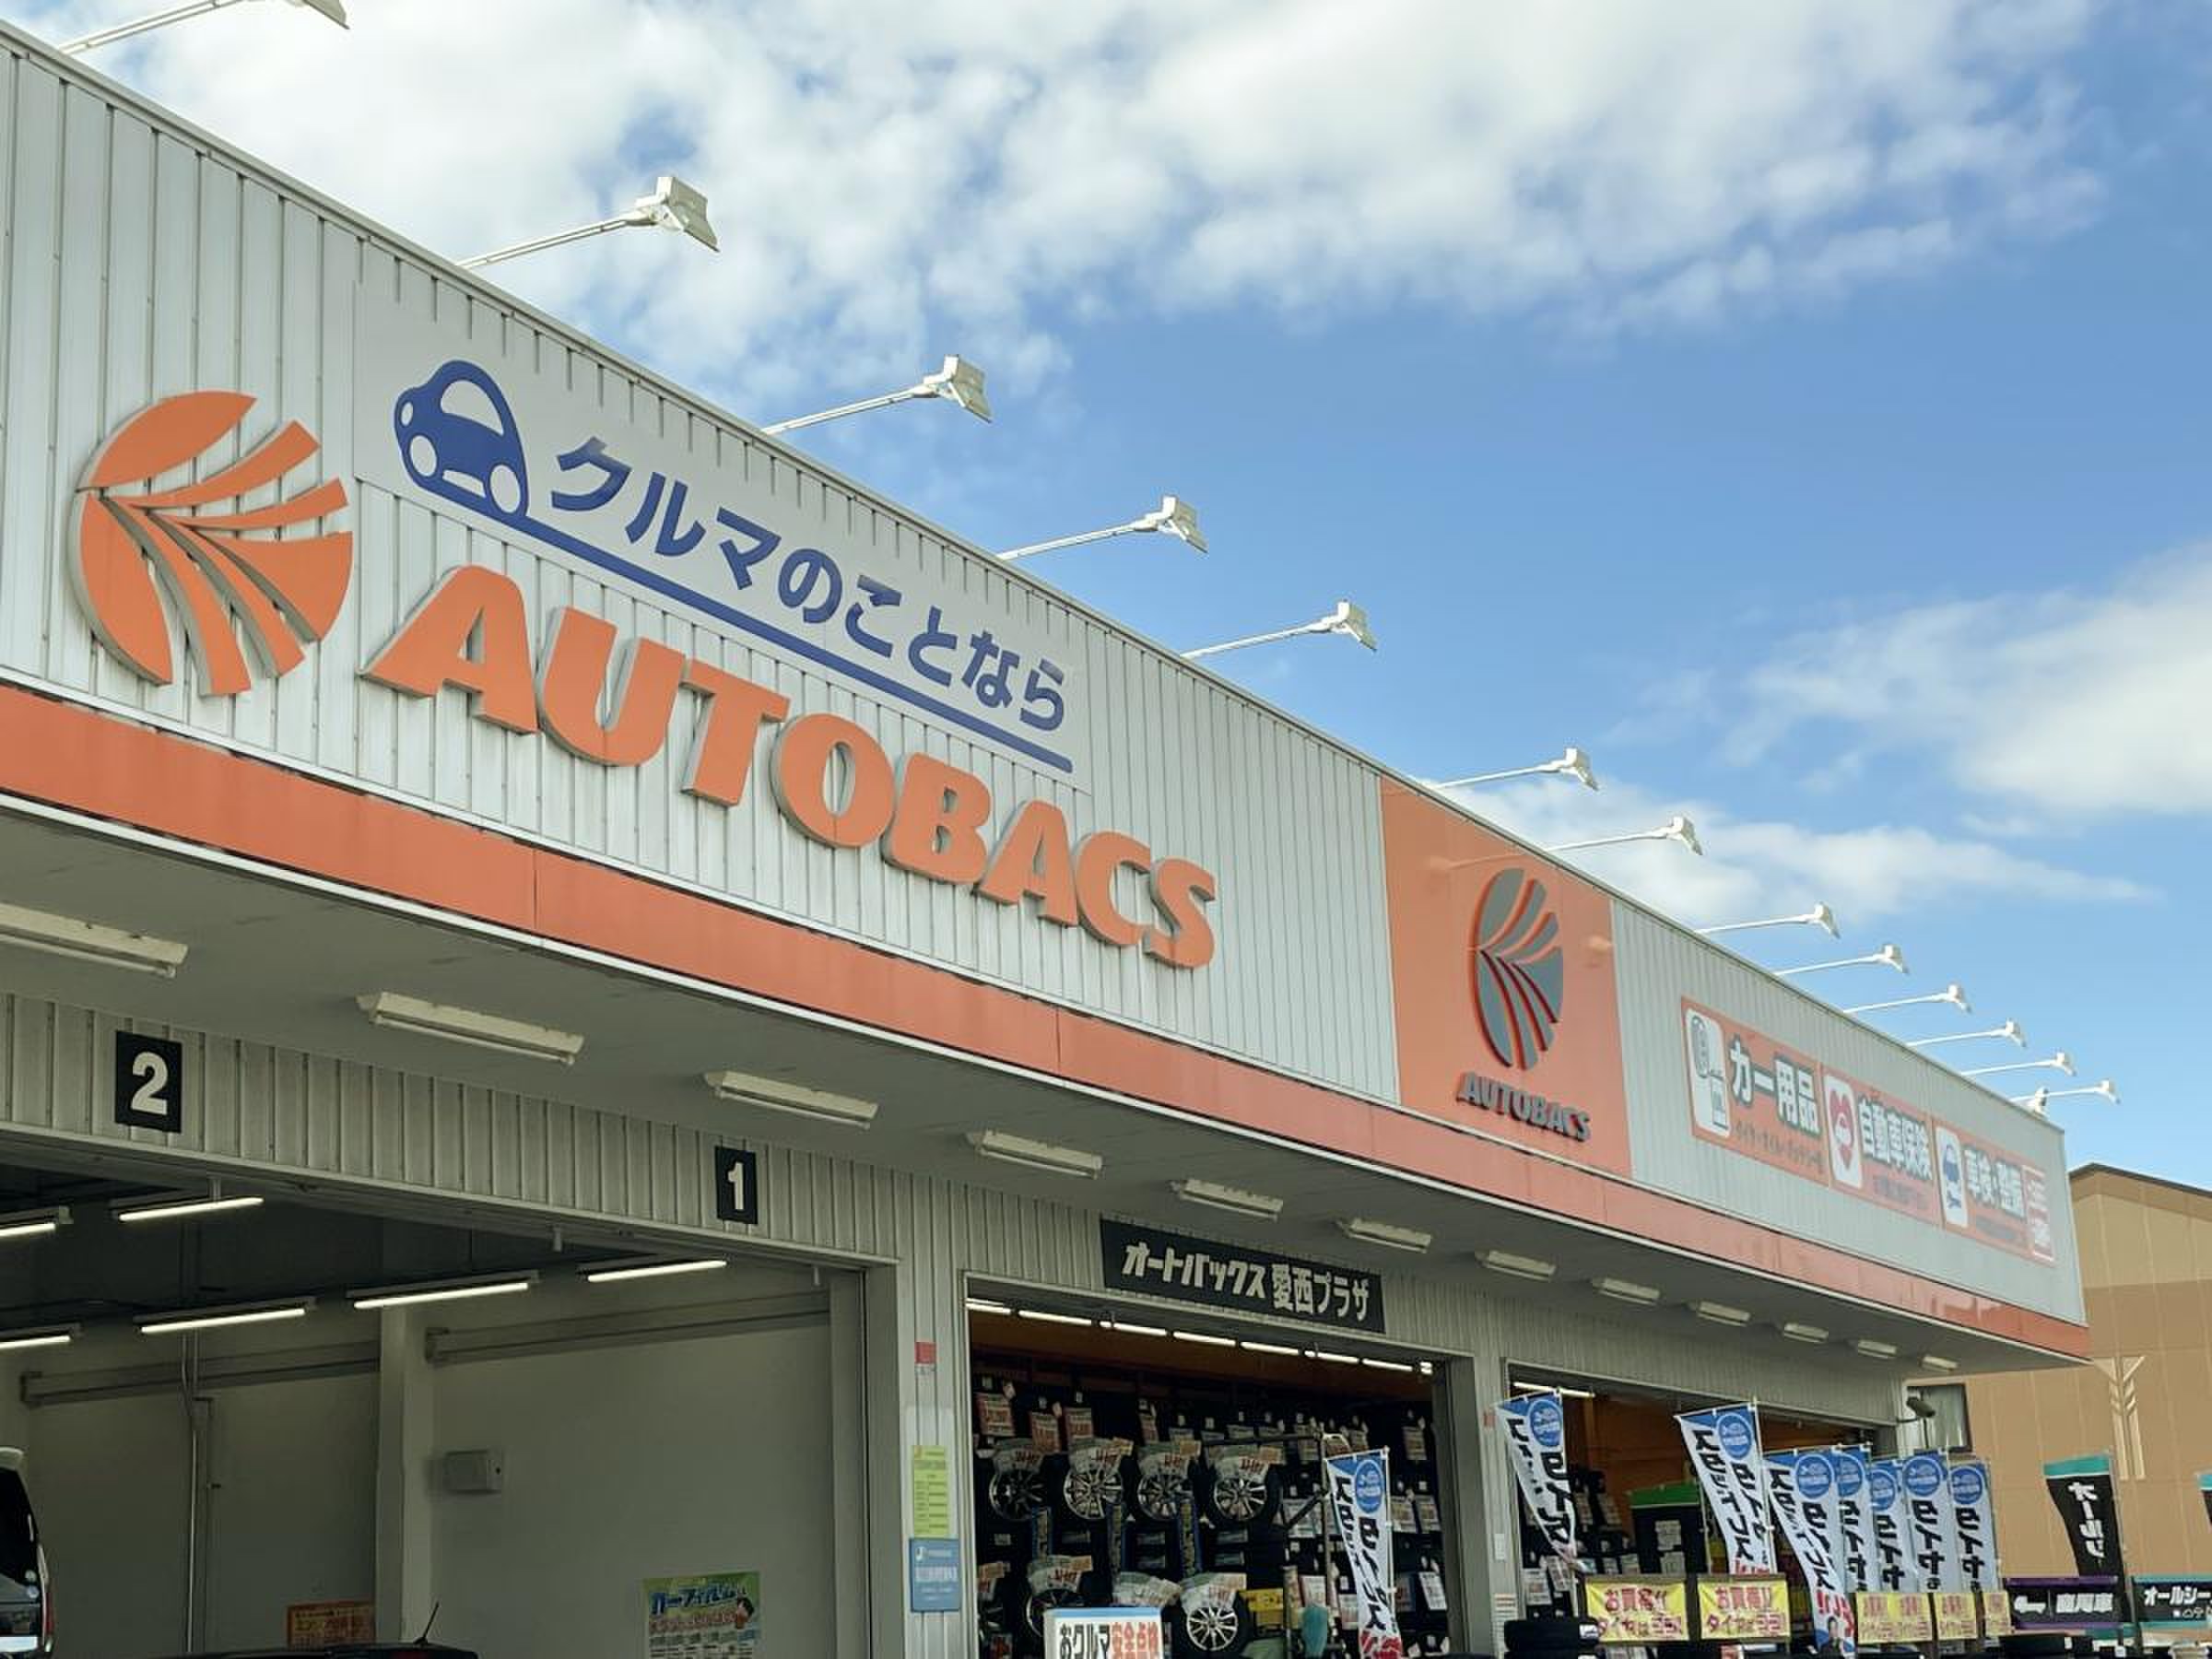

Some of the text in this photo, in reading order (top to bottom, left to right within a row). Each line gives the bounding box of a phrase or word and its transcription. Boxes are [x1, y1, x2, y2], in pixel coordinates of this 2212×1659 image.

[550, 437, 1066, 732] クルマのことなら
[358, 564, 1217, 970] AUTOBACS
[131, 1052, 169, 1115] 2
[1456, 1072, 1590, 1142] AUTOBACS
[1729, 1035, 1822, 1136] カー用品
[726, 1161, 745, 1210] 1
[1122, 1241, 1370, 1322] オートバックス 愛西プラザ
[2144, 1586, 2212, 1606] オールシー
